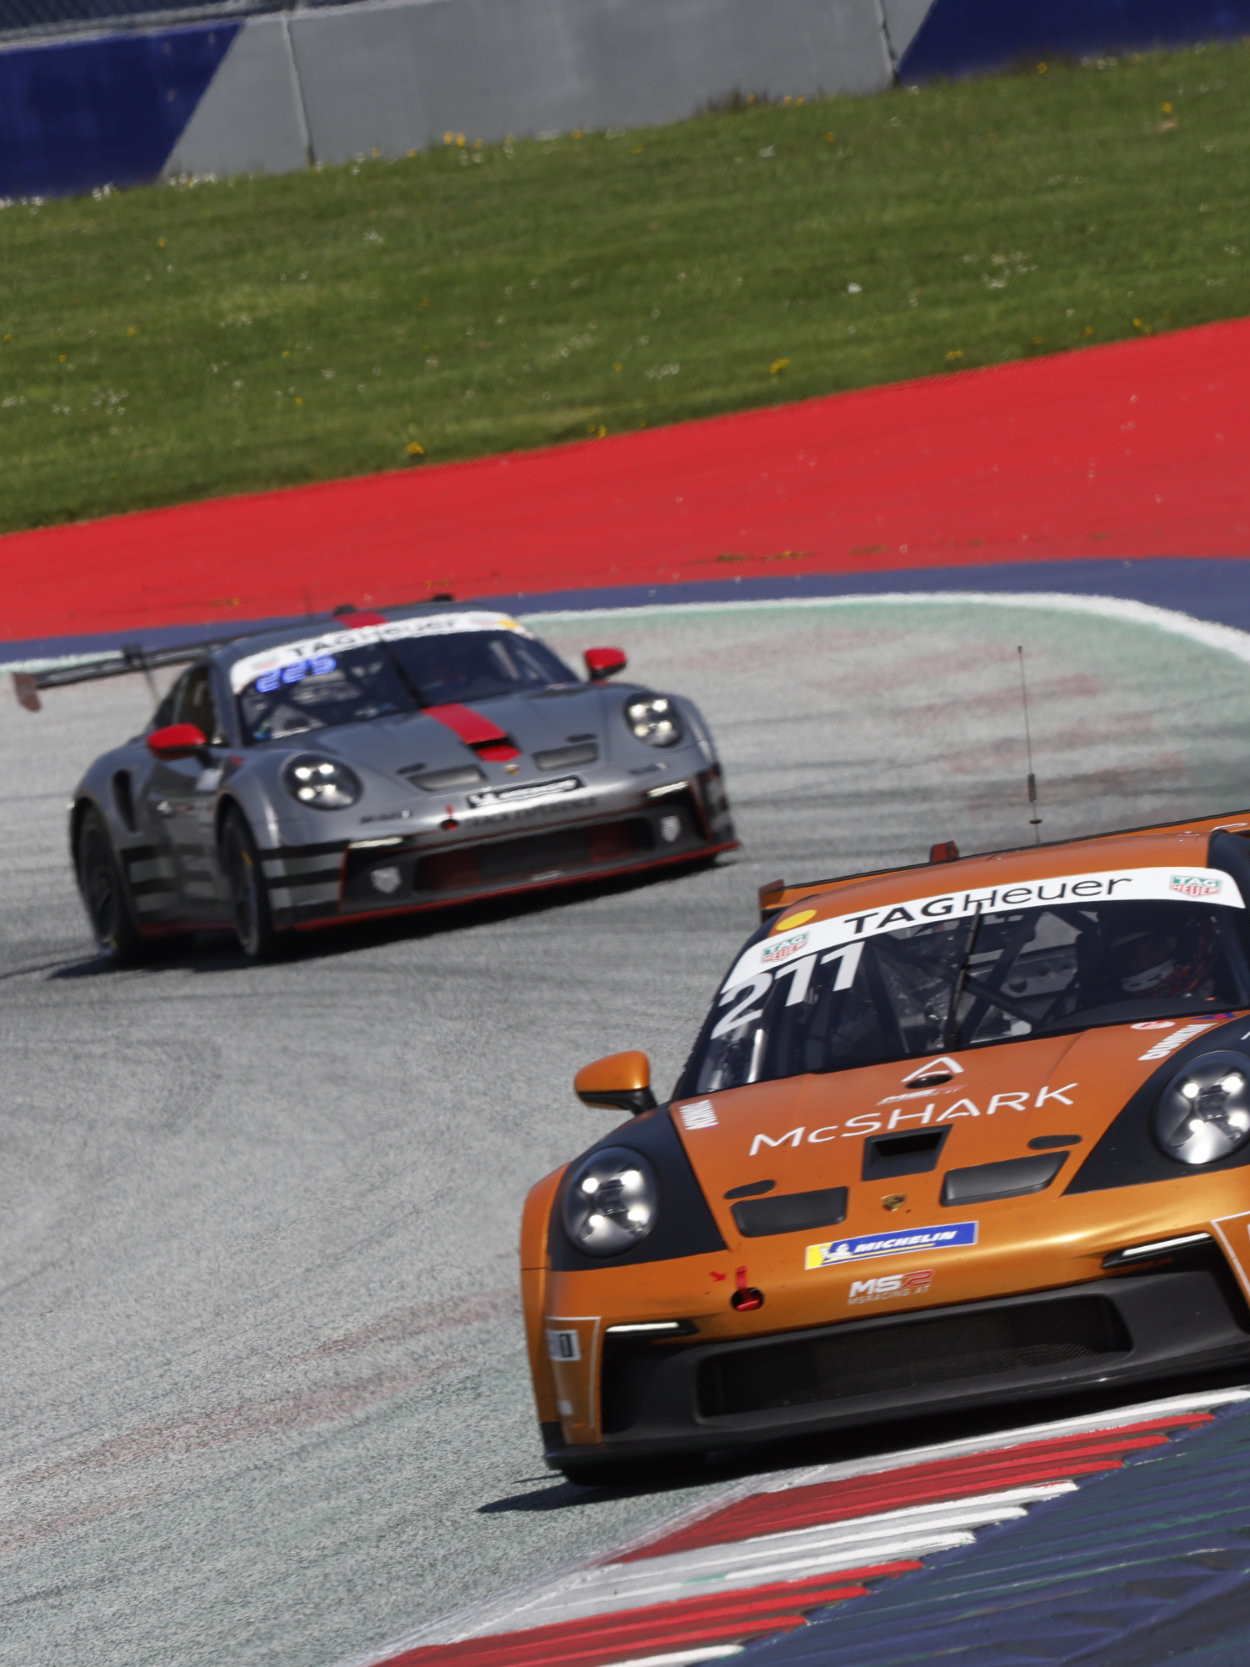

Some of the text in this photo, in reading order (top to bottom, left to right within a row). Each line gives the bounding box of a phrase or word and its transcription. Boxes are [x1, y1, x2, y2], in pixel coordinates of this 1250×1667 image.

[1171, 884, 1219, 897] HEUER
[1175, 876, 1219, 888] TAG
[767, 932, 809, 957] TAG
[710, 941, 866, 1040] 211
[748, 1083, 1079, 1157] McSHARK
[853, 1230, 958, 1254] MICHELIN
